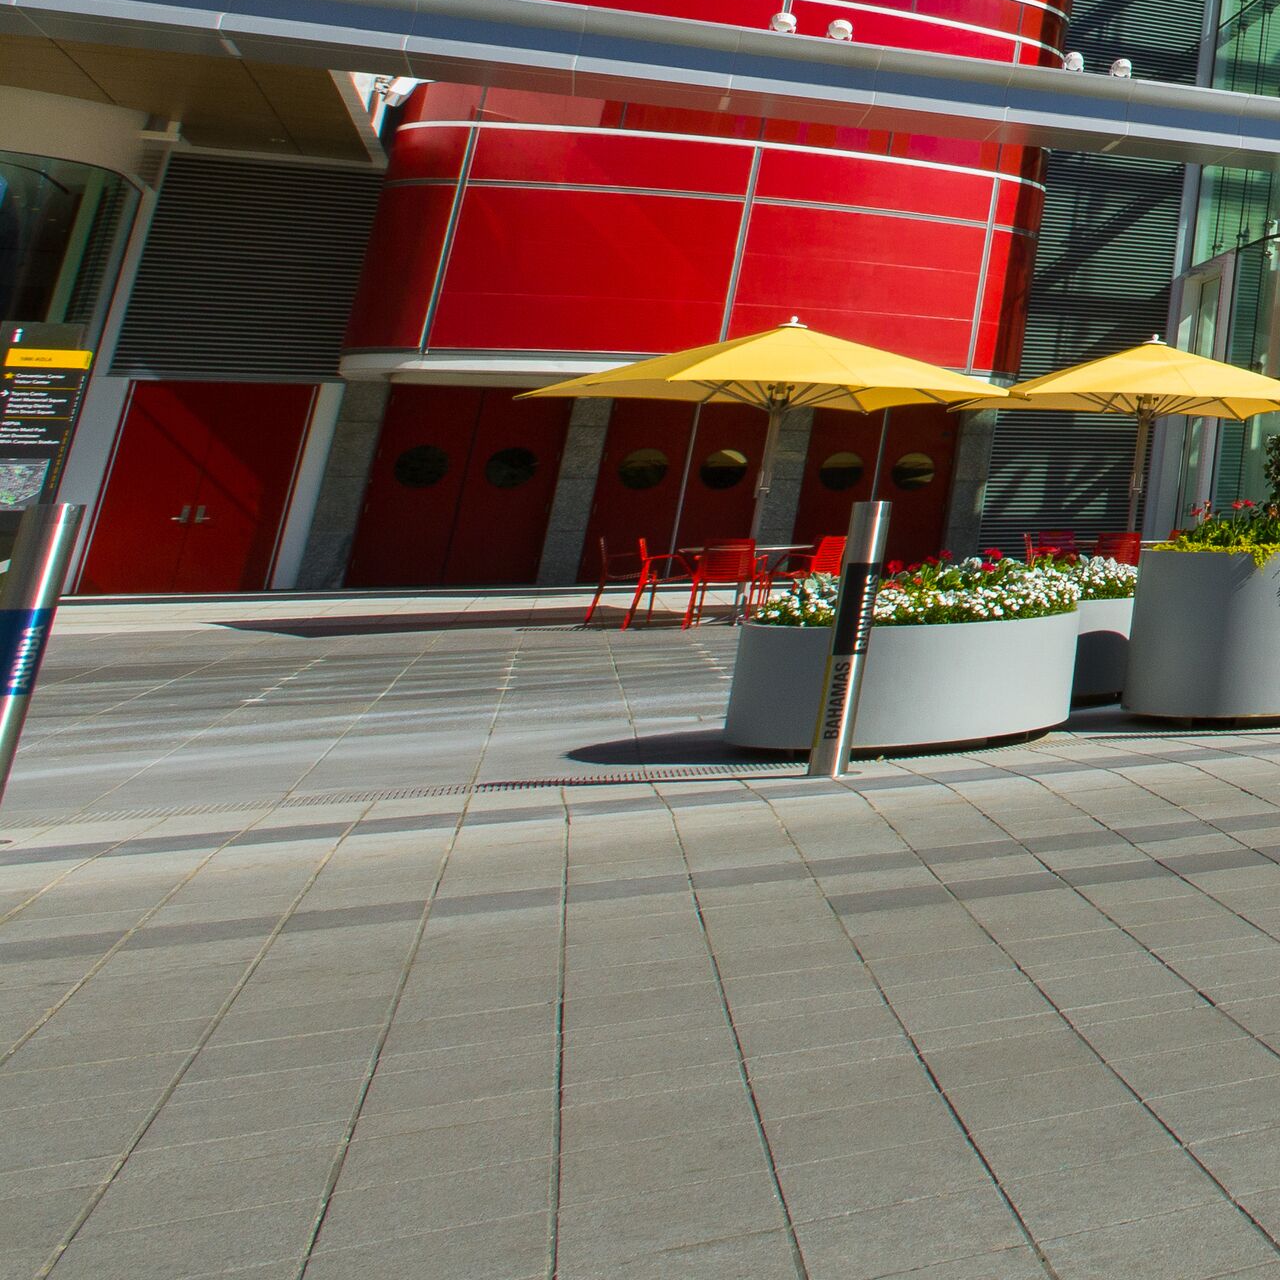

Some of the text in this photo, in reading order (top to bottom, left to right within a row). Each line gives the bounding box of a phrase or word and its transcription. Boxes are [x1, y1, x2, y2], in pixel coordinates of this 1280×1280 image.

[854, 574, 879, 651] BAHAMAS
[7, 624, 46, 688] ARUBA
[824, 661, 851, 740] BAHAMAS
